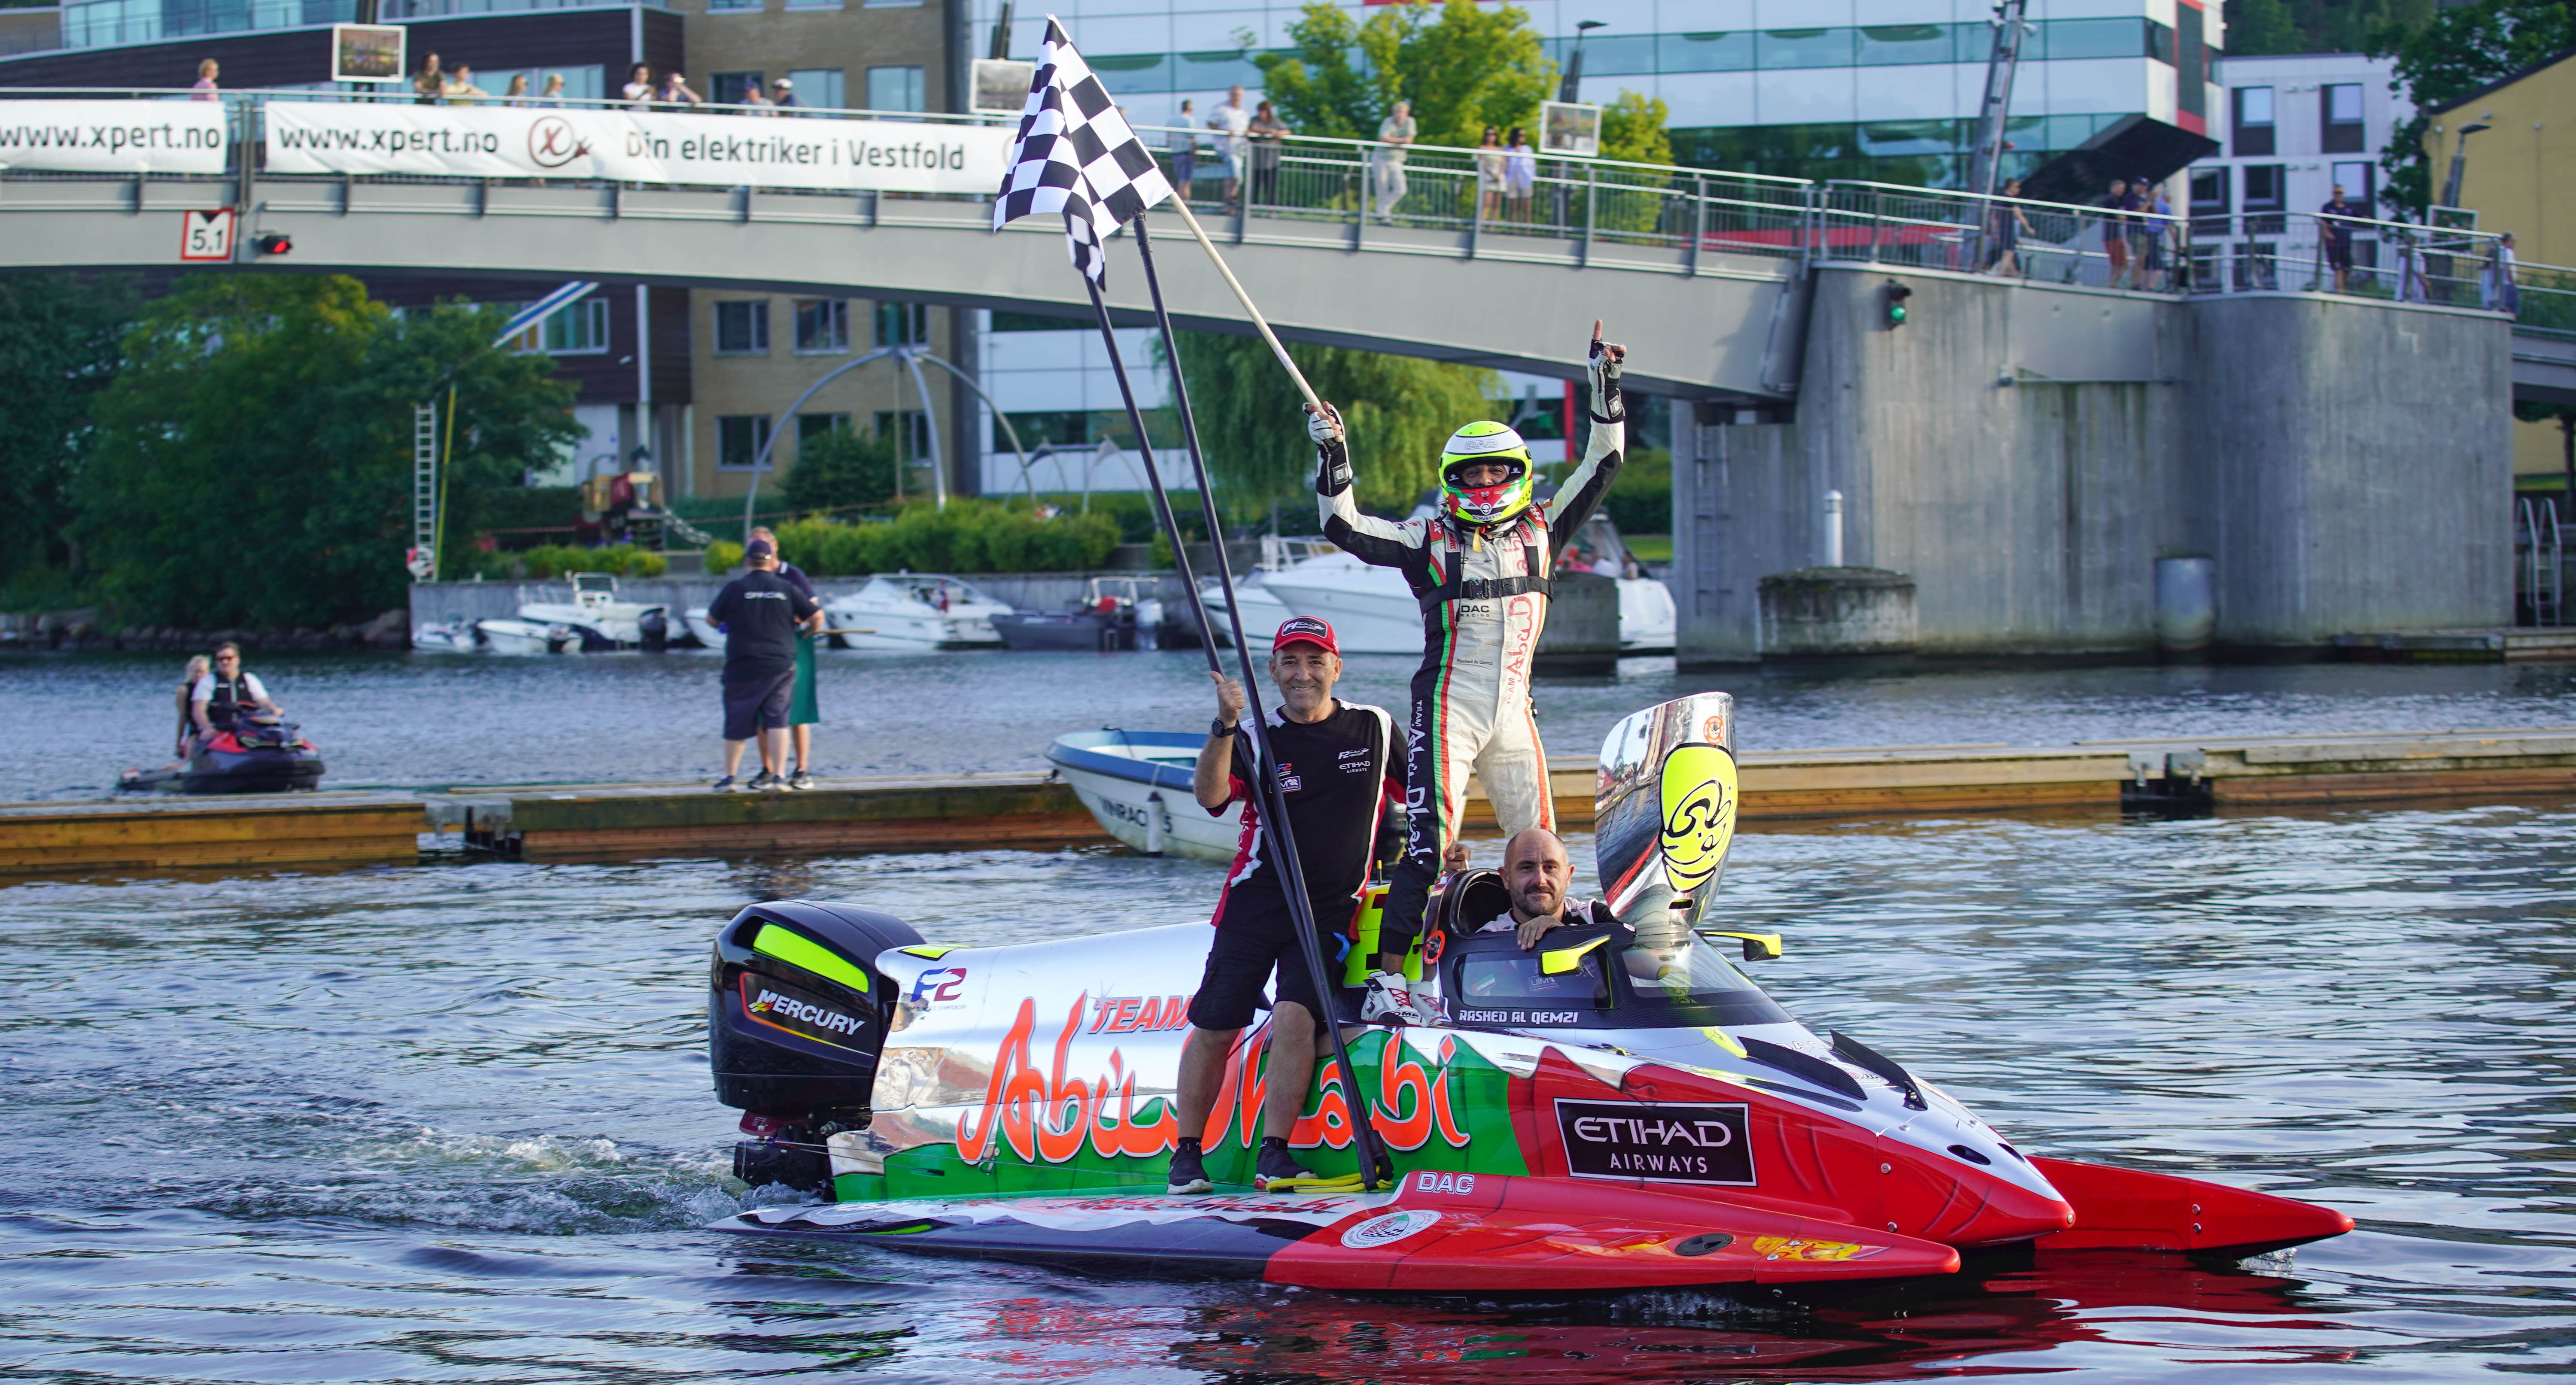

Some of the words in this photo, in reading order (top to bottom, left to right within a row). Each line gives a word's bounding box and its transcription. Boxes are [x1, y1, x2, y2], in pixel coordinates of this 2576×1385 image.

[0, 124, 220, 155] www.xpert.no
[279, 125, 499, 158] www.xpert.no
[626, 131, 669, 159] Din
[681, 134, 822, 166] elektriker
[832, 138, 838, 166] i
[848, 140, 965, 170] Vestfold
[191, 229, 224, 253] 5,1
[1466, 440, 1497, 449] DAC
[1339, 761, 1371, 770] ETIHAD
[910, 966, 967, 1002] F2
[756, 989, 866, 1036] MERCURY
[1088, 995, 1195, 1034] TEAM
[1459, 1010, 1507, 1023] RASHED
[955, 990, 1179, 1166] Abu
[1574, 1116, 1732, 1147] ETIHAD
[1610, 1152, 1708, 1173] AIRWAYS
[1416, 1171, 1475, 1195] DAC
